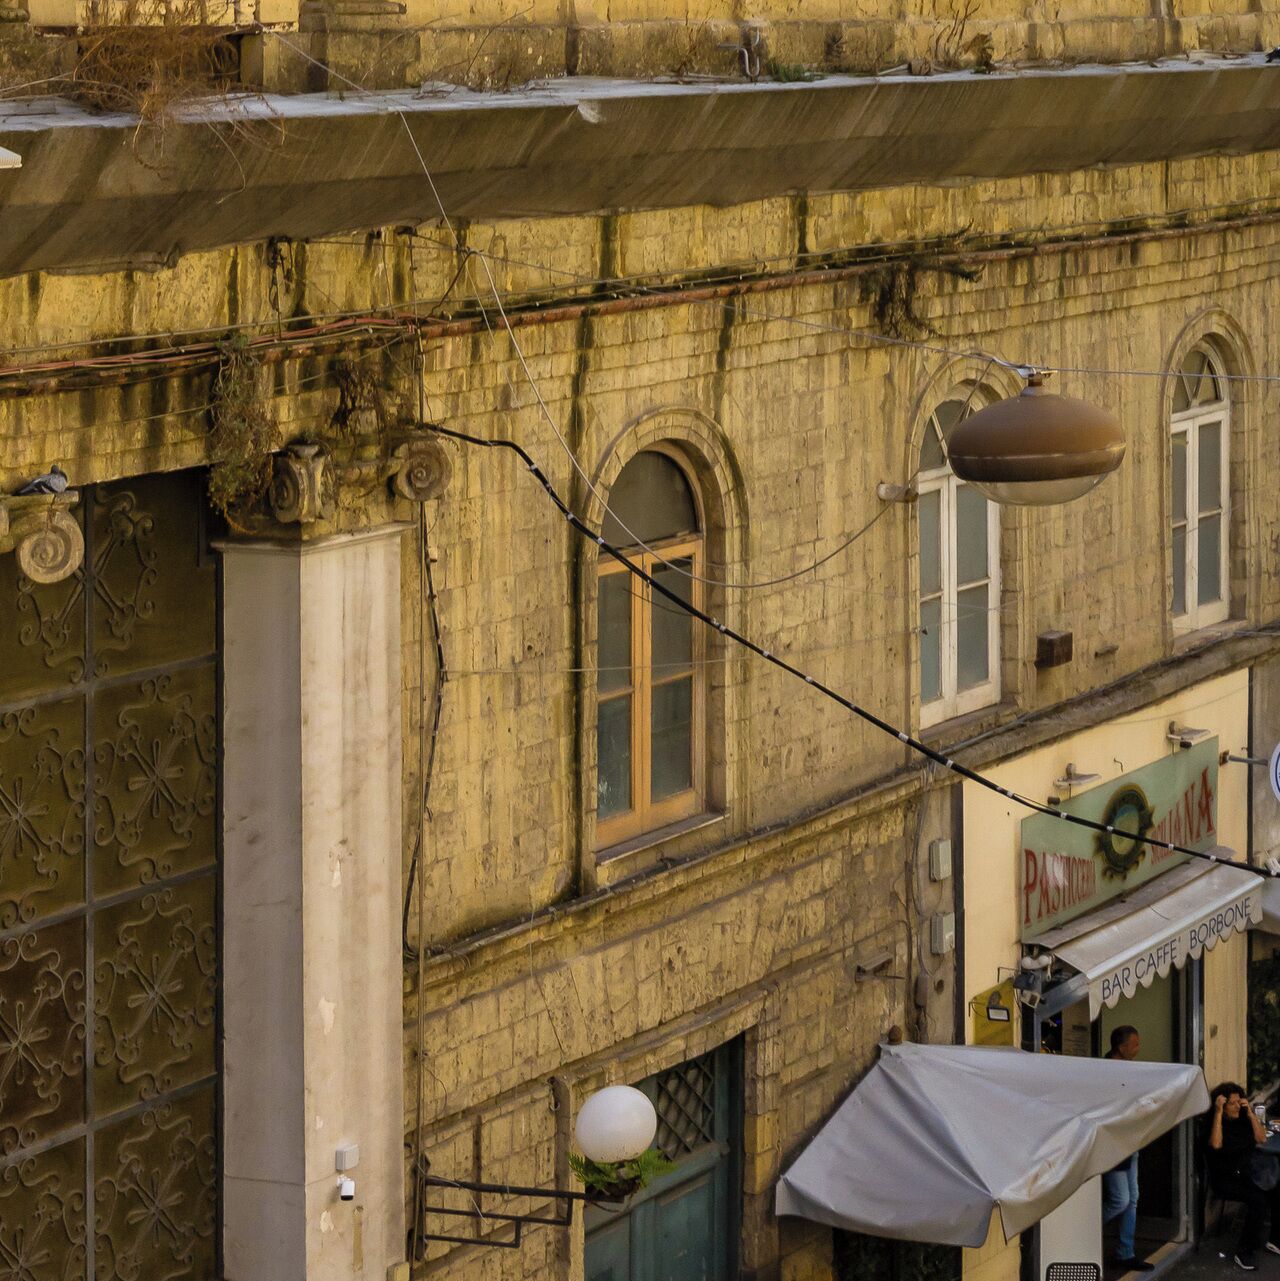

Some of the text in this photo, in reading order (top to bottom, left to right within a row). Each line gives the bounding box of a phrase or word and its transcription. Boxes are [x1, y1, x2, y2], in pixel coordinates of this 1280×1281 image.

[1101, 896, 1251, 1001] BAR CAFFE' BORBONE
